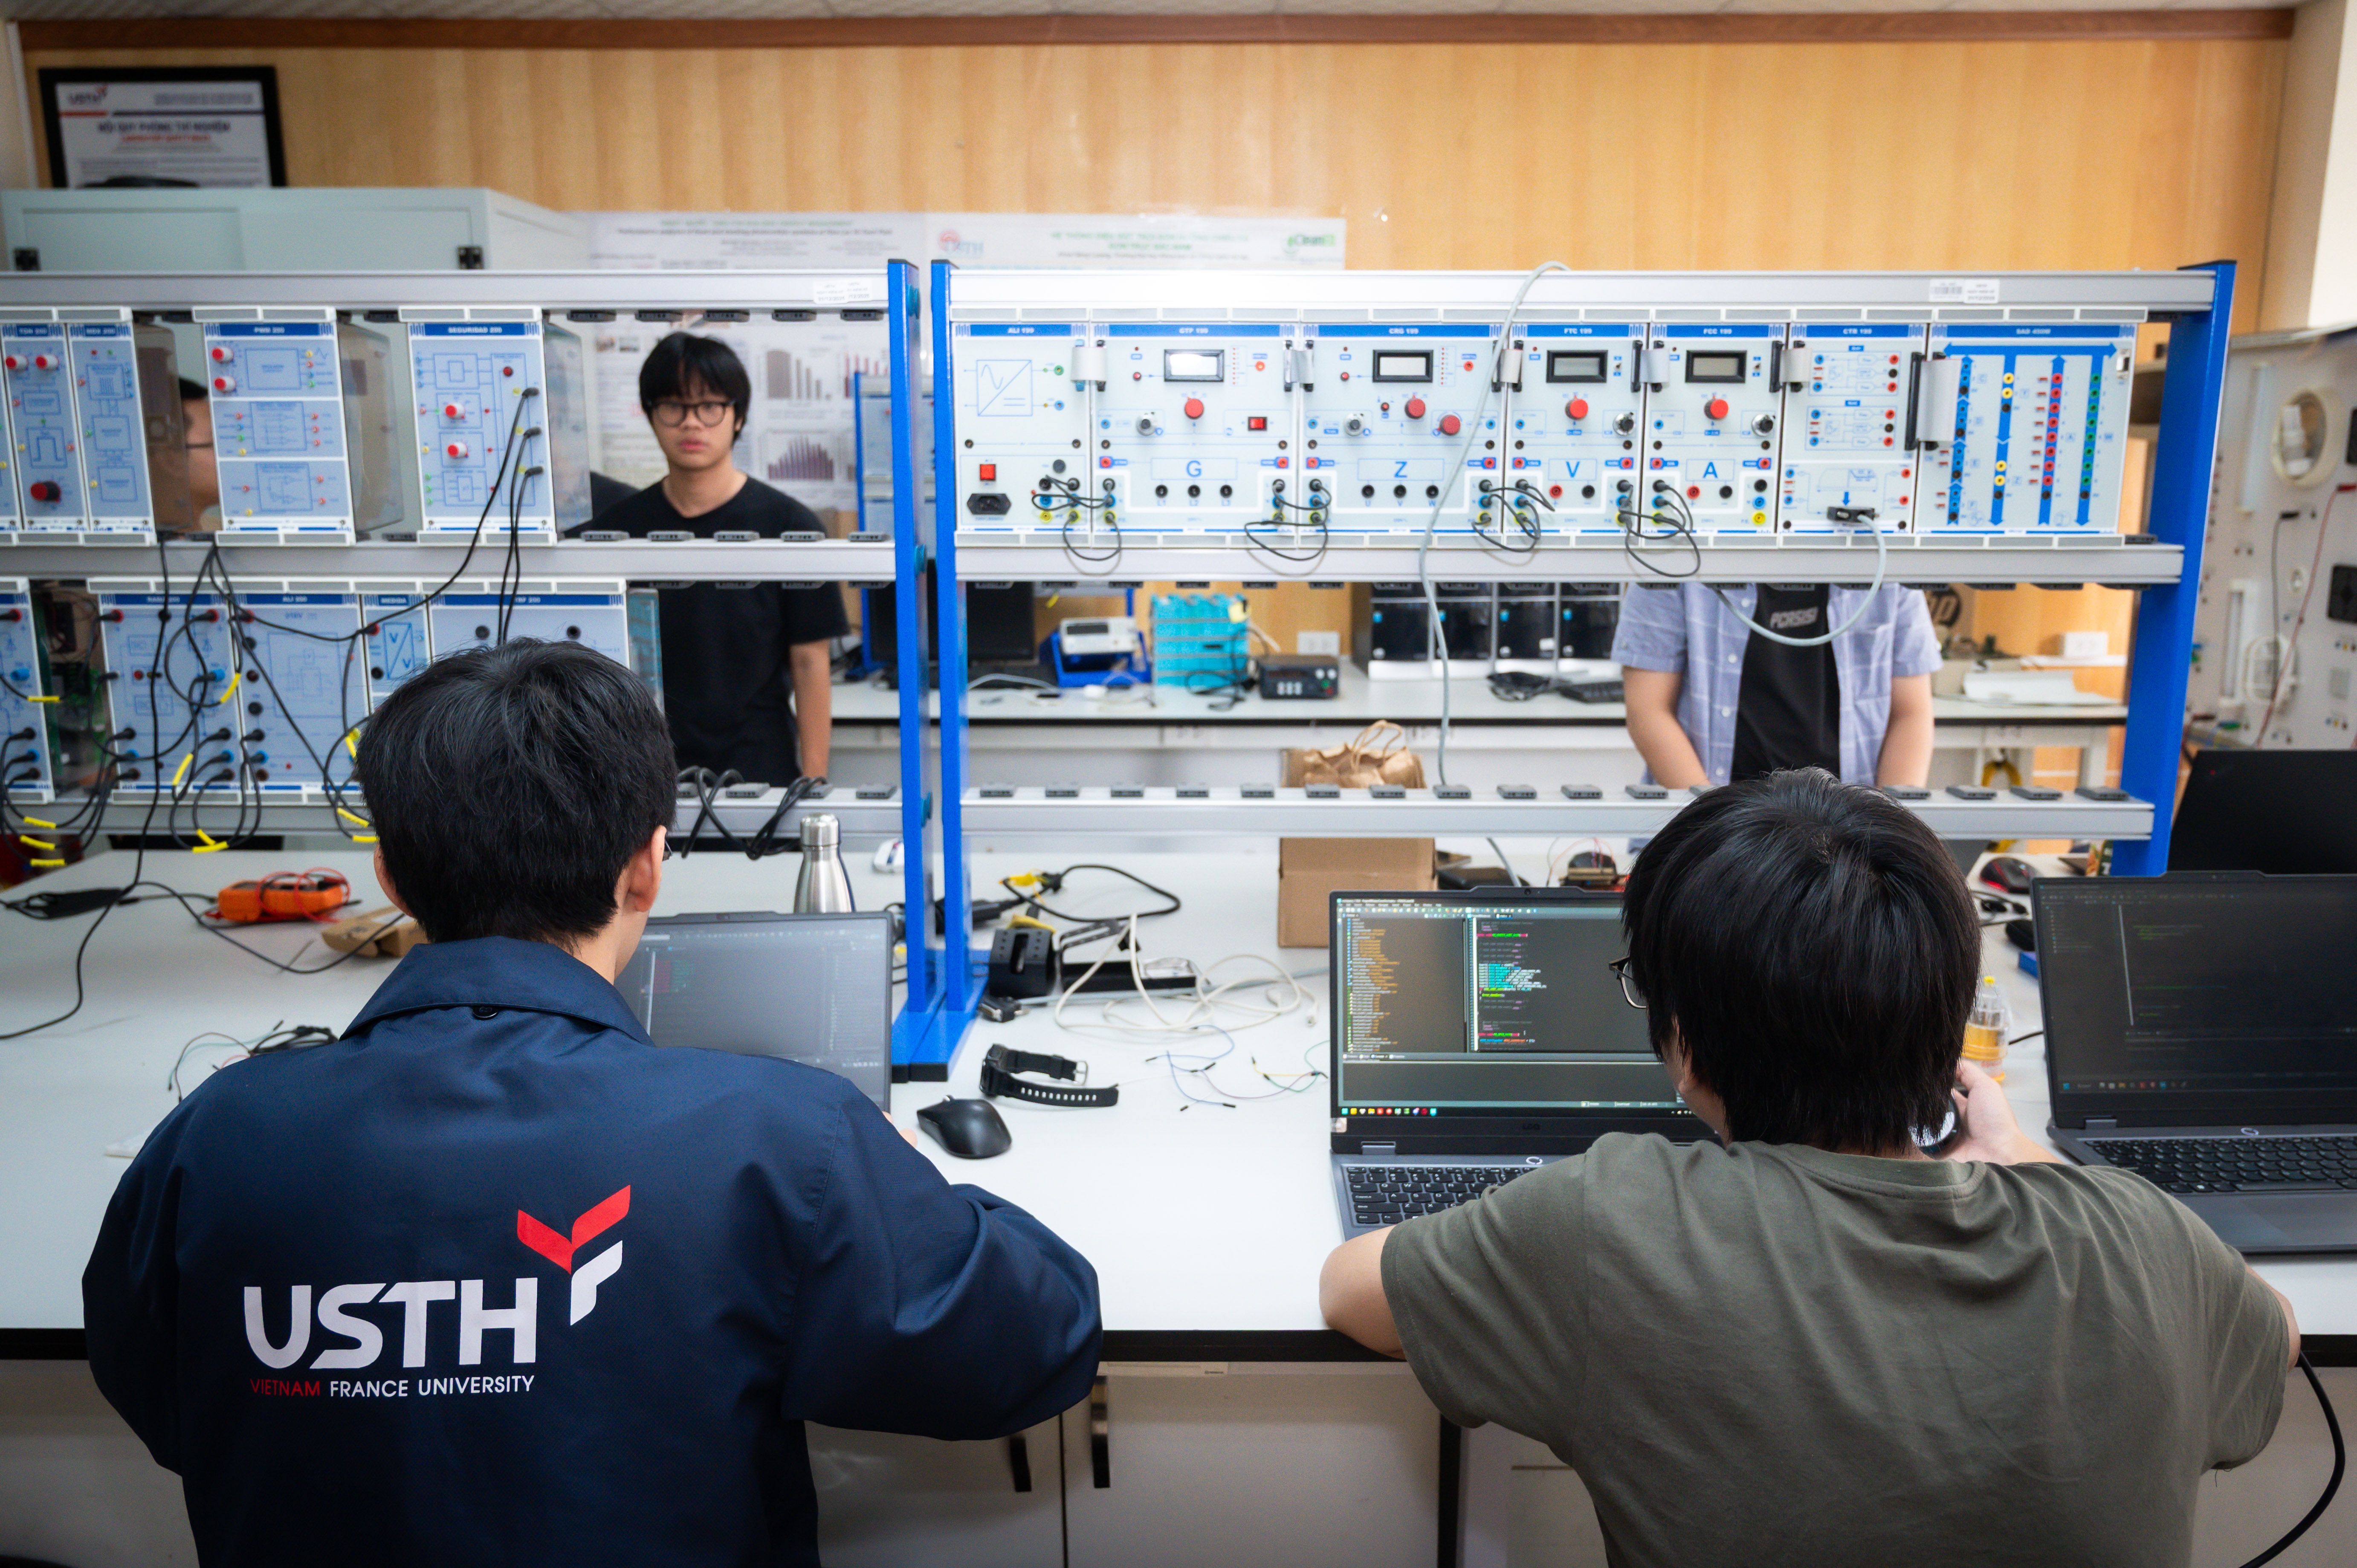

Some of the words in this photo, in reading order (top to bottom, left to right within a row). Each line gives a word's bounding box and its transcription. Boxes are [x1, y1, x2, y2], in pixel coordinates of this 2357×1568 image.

[1187, 460, 1202, 477] G
[1395, 462, 1407, 478] Z
[1566, 461, 1580, 478] V
[1703, 462, 1718, 478] A
[390, 633, 398, 643] V
[403, 658, 411, 668] V
[244, 1277, 538, 1369] USTH
[250, 1378, 321, 1397] VIETNAM
[330, 1379, 408, 1397] FRANCE
[418, 1375, 535, 1395] UNIVERSITY
